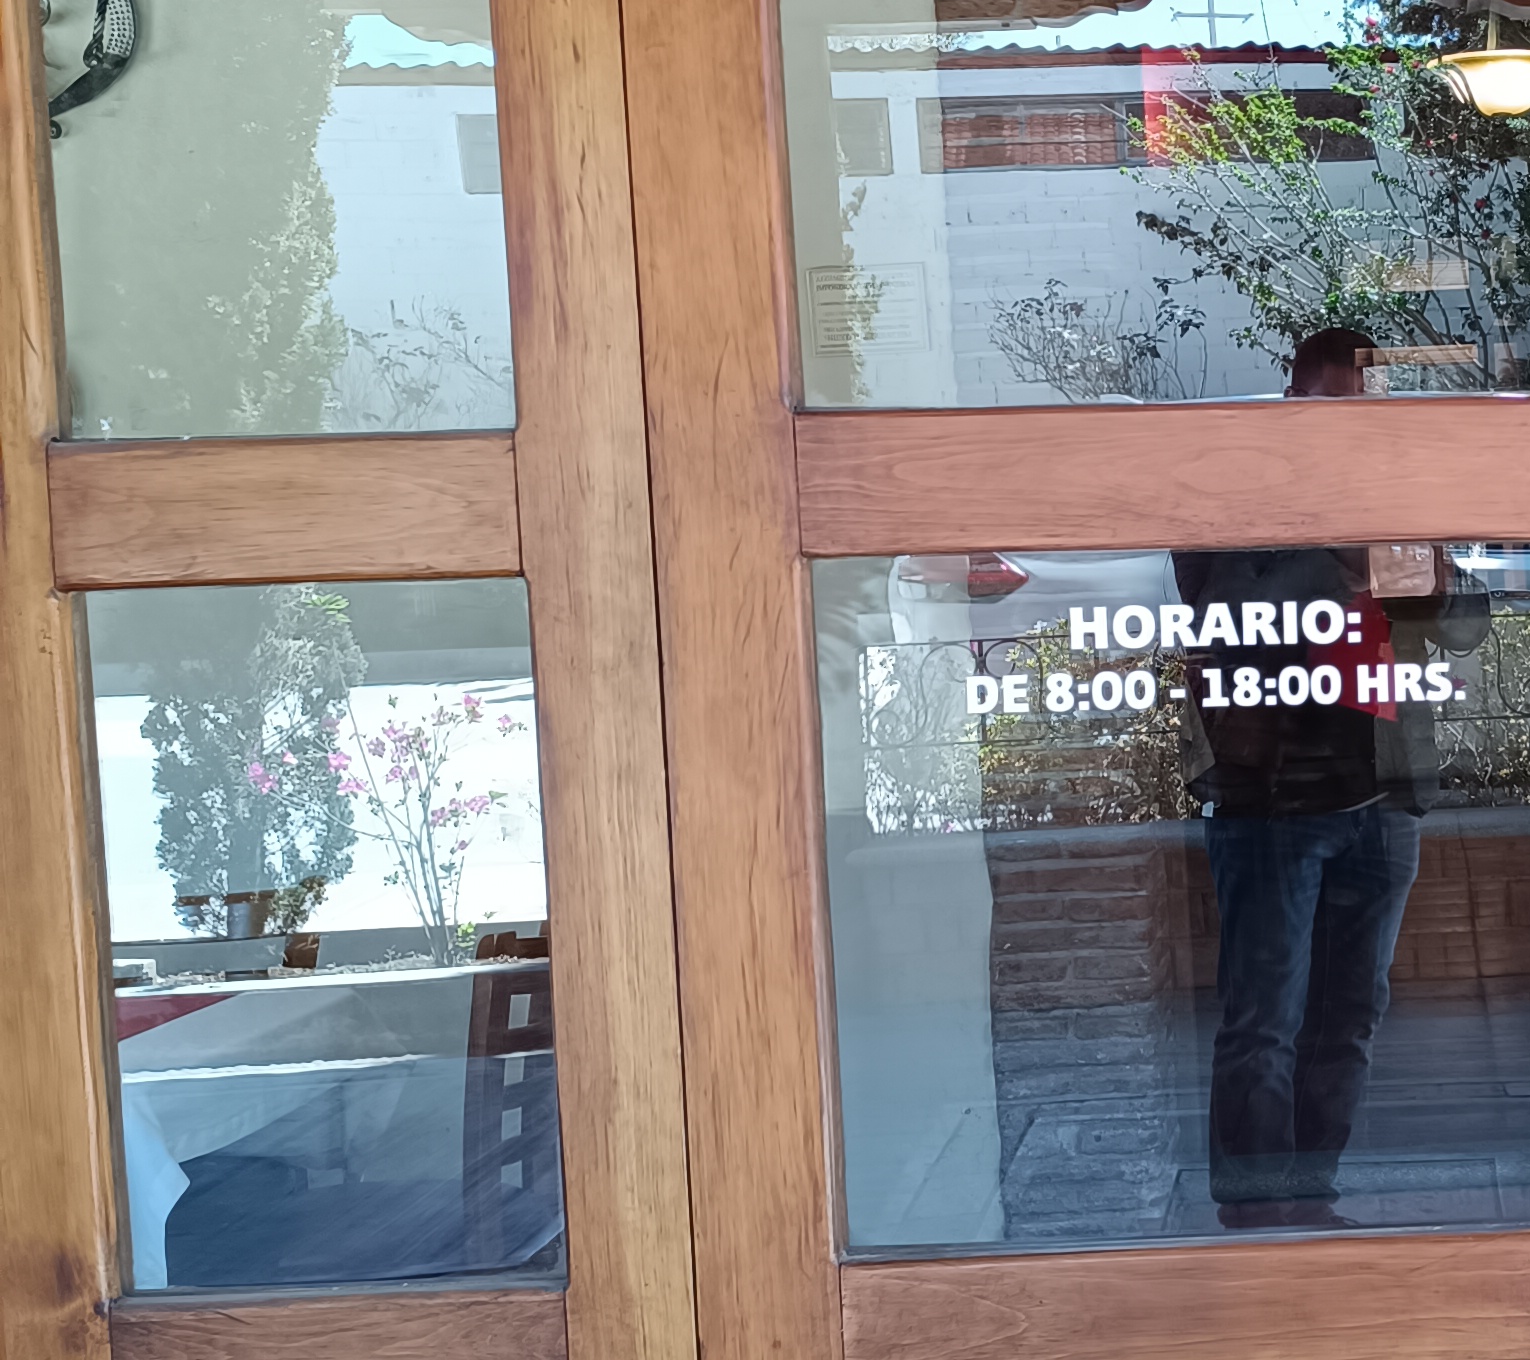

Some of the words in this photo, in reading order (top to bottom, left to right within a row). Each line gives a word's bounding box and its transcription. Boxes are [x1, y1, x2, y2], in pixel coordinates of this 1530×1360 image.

[1068, 599, 1362, 650] HORARIO:
[965, 674, 1031, 714] DE
[1046, 670, 1156, 712] 8:00
[1202, 665, 1342, 708] 18:00
[1356, 662, 1467, 703] HRS.
